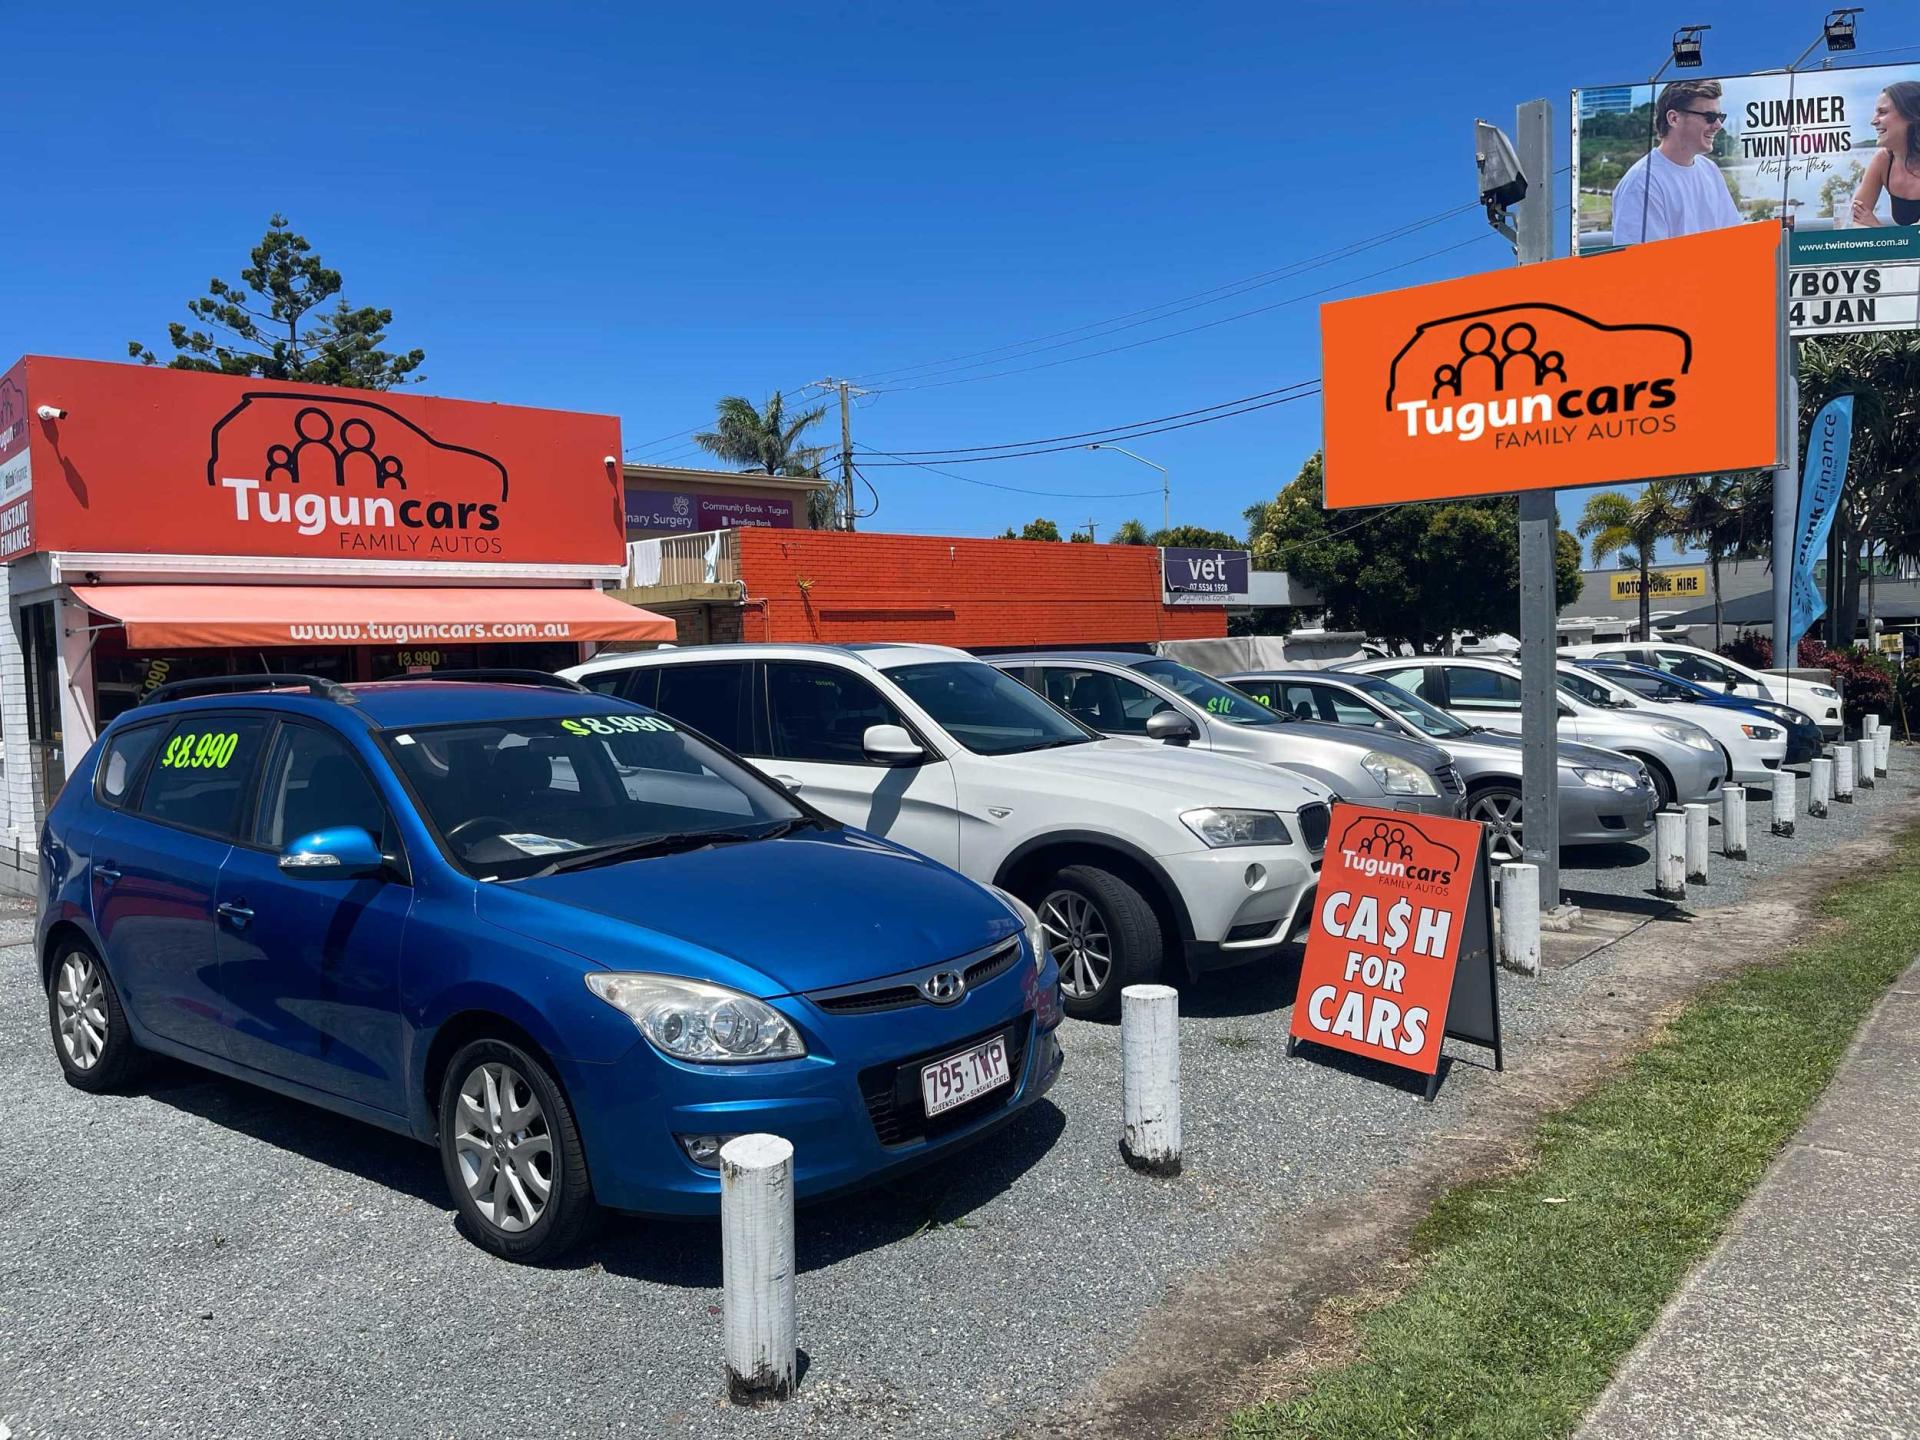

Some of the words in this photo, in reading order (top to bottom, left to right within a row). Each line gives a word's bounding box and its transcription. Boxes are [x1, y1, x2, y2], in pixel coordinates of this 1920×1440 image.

[1746, 96, 1844, 128] SUMMER
[1791, 126, 1801, 134] AT
[1741, 136, 1785, 158] TWIN
[1790, 131, 1851, 155] TOWNS
[1798, 239, 1909, 252] www.twintowns.com.au
[1812, 298, 1876, 325] JAN
[1397, 378, 1677, 442] Tuguncars
[1495, 424, 1577, 450] FAMILY
[1587, 414, 1677, 441] AUTOS
[0, 501, 28, 533] INSTANT
[221, 477, 501, 536] Tuguncars
[702, 501, 744, 514] Community
[745, 504, 764, 513] Bank
[768, 506, 789, 516] Tugun
[653, 513, 693, 528] Surgery
[731, 518, 756, 527] Bendigo
[756, 519, 772, 527] Bank
[0, 525, 30, 557] FINANCE
[340, 532, 421, 552] FAMILY
[430, 535, 502, 554] AUTOS
[1188, 554, 1226, 580] vet
[1198, 583, 1213, 591] 5534
[1677, 577, 1698, 591] HIRE
[290, 621, 570, 643] www.tuguncars.com.au
[1343, 849, 1451, 885] Tuguncars
[1378, 876, 1413, 889] FAMILY
[1415, 884, 1449, 897] AUTOS
[1321, 891, 1453, 960] CA$H
[1343, 951, 1406, 995] FOR
[1307, 984, 1430, 1055] CARS
[931, 1093, 966, 1114] QUEENSLAND
[970, 1080, 993, 1097] SUNSHINE
[993, 1073, 1008, 1087] STATE
